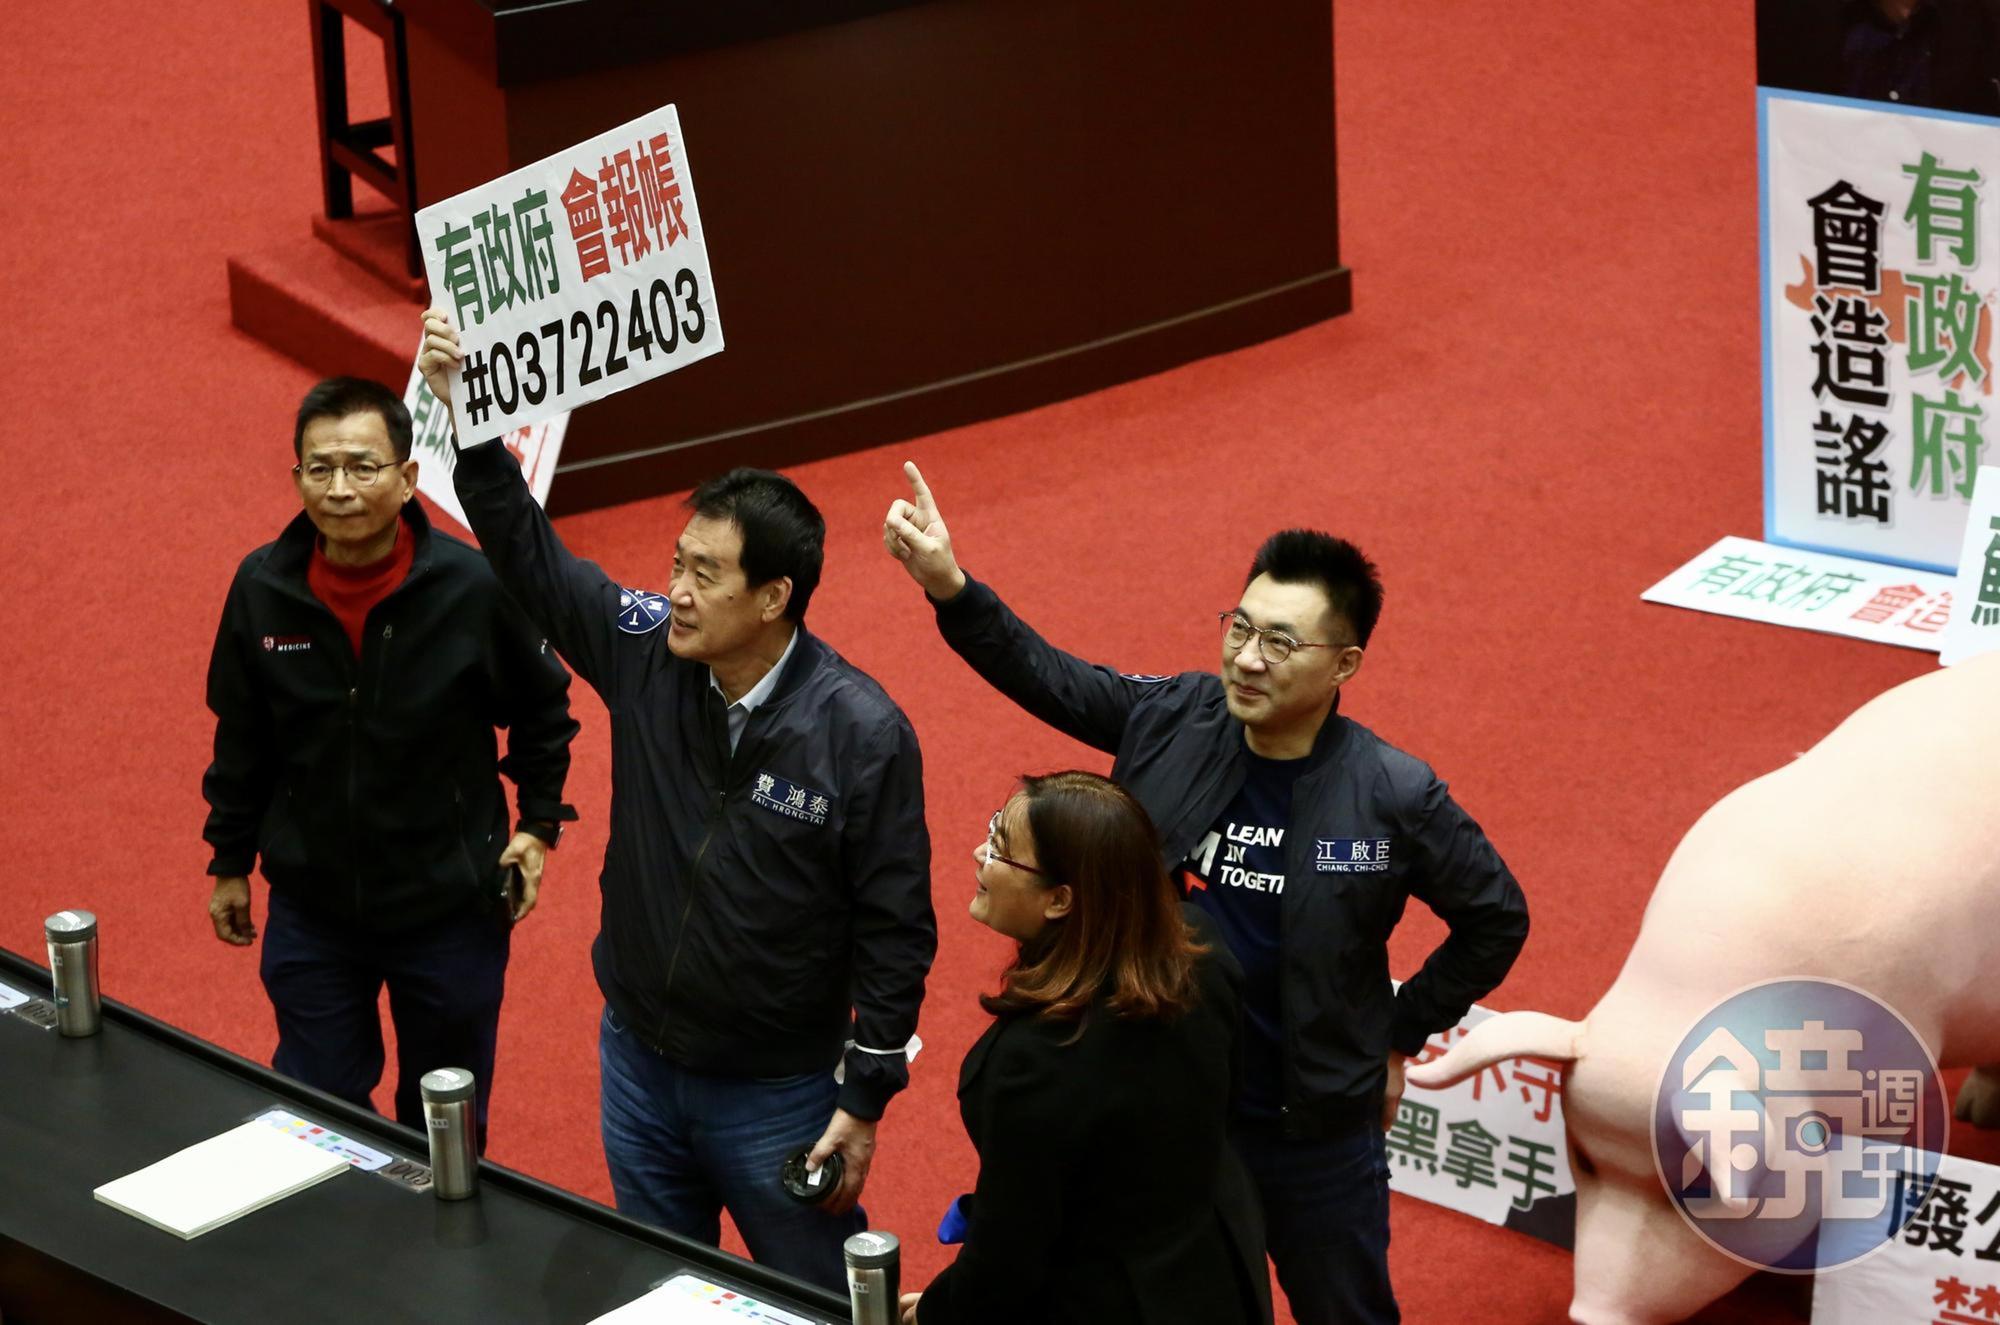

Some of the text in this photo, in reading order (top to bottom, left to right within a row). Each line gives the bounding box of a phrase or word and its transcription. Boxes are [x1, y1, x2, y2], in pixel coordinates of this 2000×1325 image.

[435, 132, 689, 331] 有政府 會報帳
[461, 268, 706, 427] #03722403
[1807, 179, 1891, 524] 會造謠
[1901, 150, 1985, 501] 有政府
[1686, 554, 1867, 612] 有政府
[1223, 843, 1247, 864] IN
[1226, 822, 1285, 847] LEAN
